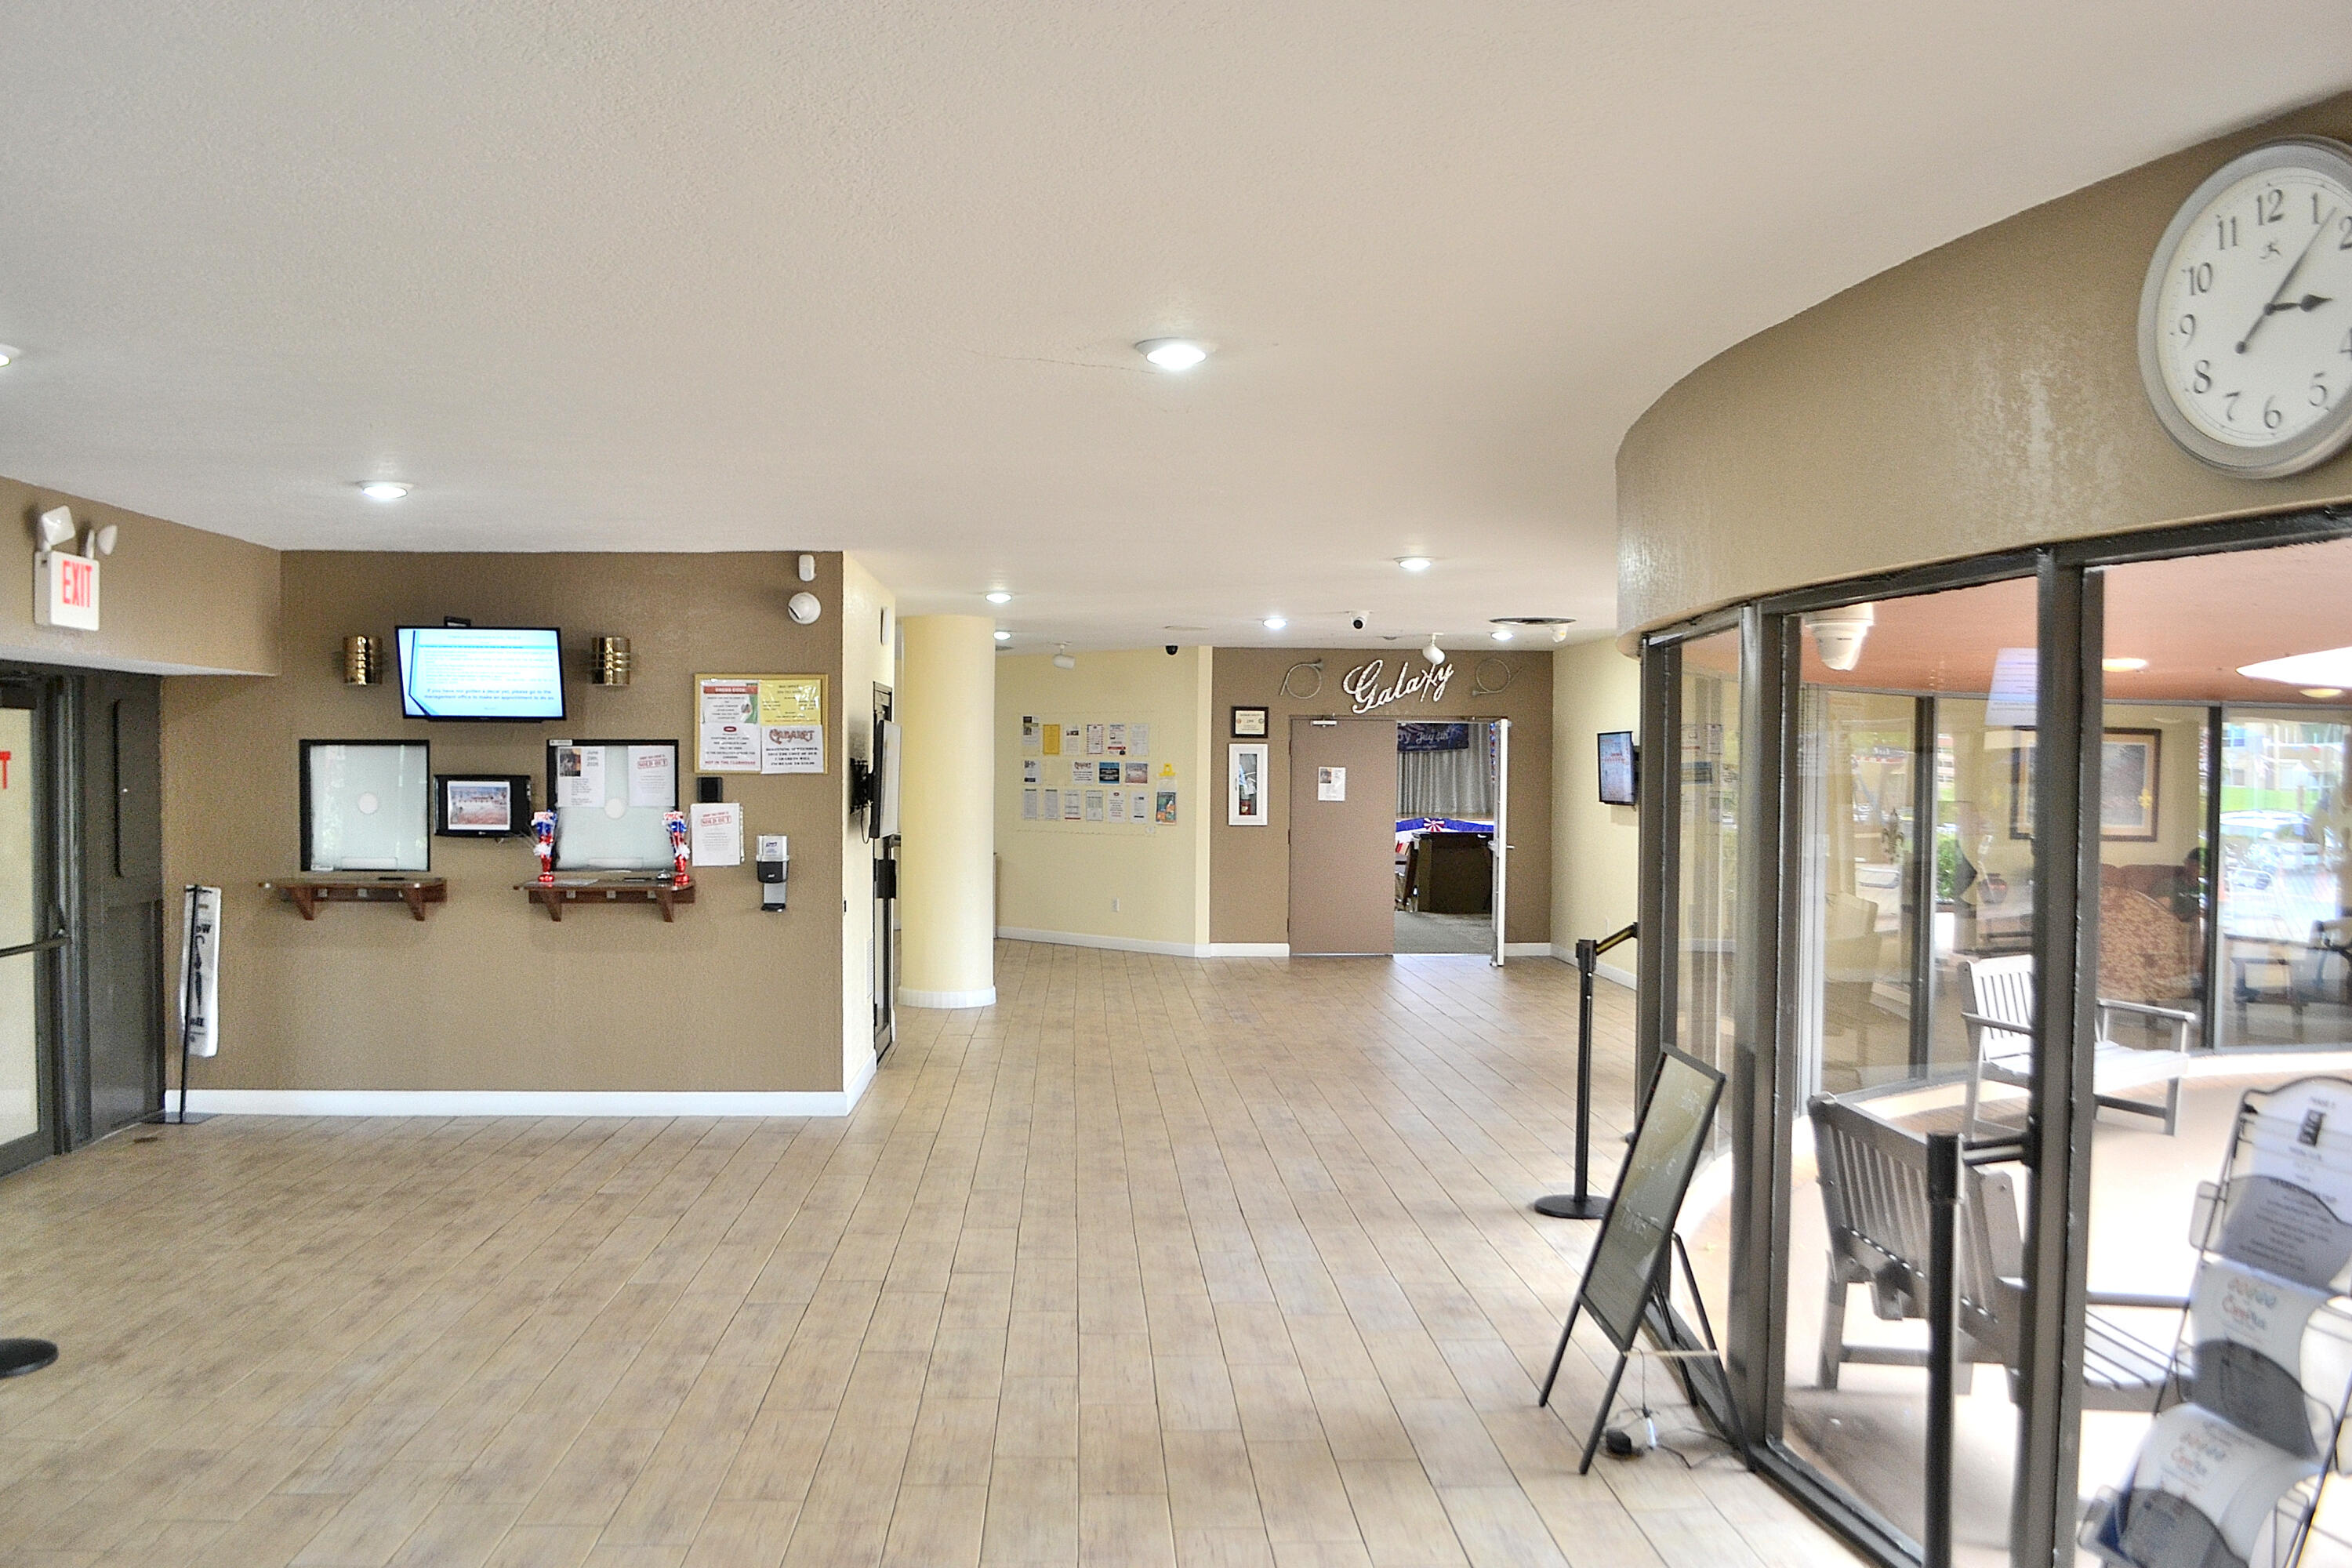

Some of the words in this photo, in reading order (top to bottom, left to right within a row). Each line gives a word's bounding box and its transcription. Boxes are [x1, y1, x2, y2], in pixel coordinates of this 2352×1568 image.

[2256, 189, 2283, 226] 12
[2312, 193, 2321, 224] 1
[2218, 216, 2238, 250] 11
[2339, 215, 2352, 250] 2
[2183, 262, 2212, 296] 10
[2180, 314, 2196, 348] 9
[2194, 360, 2212, 394] 8
[2310, 372, 2327, 407] 5
[2225, 391, 2241, 421] 7
[2264, 395, 2281, 429] 6
[62, 560, 93, 608] EXIT
[1342, 659, 1454, 714] Galaxy
[0, 750, 11, 789] T
